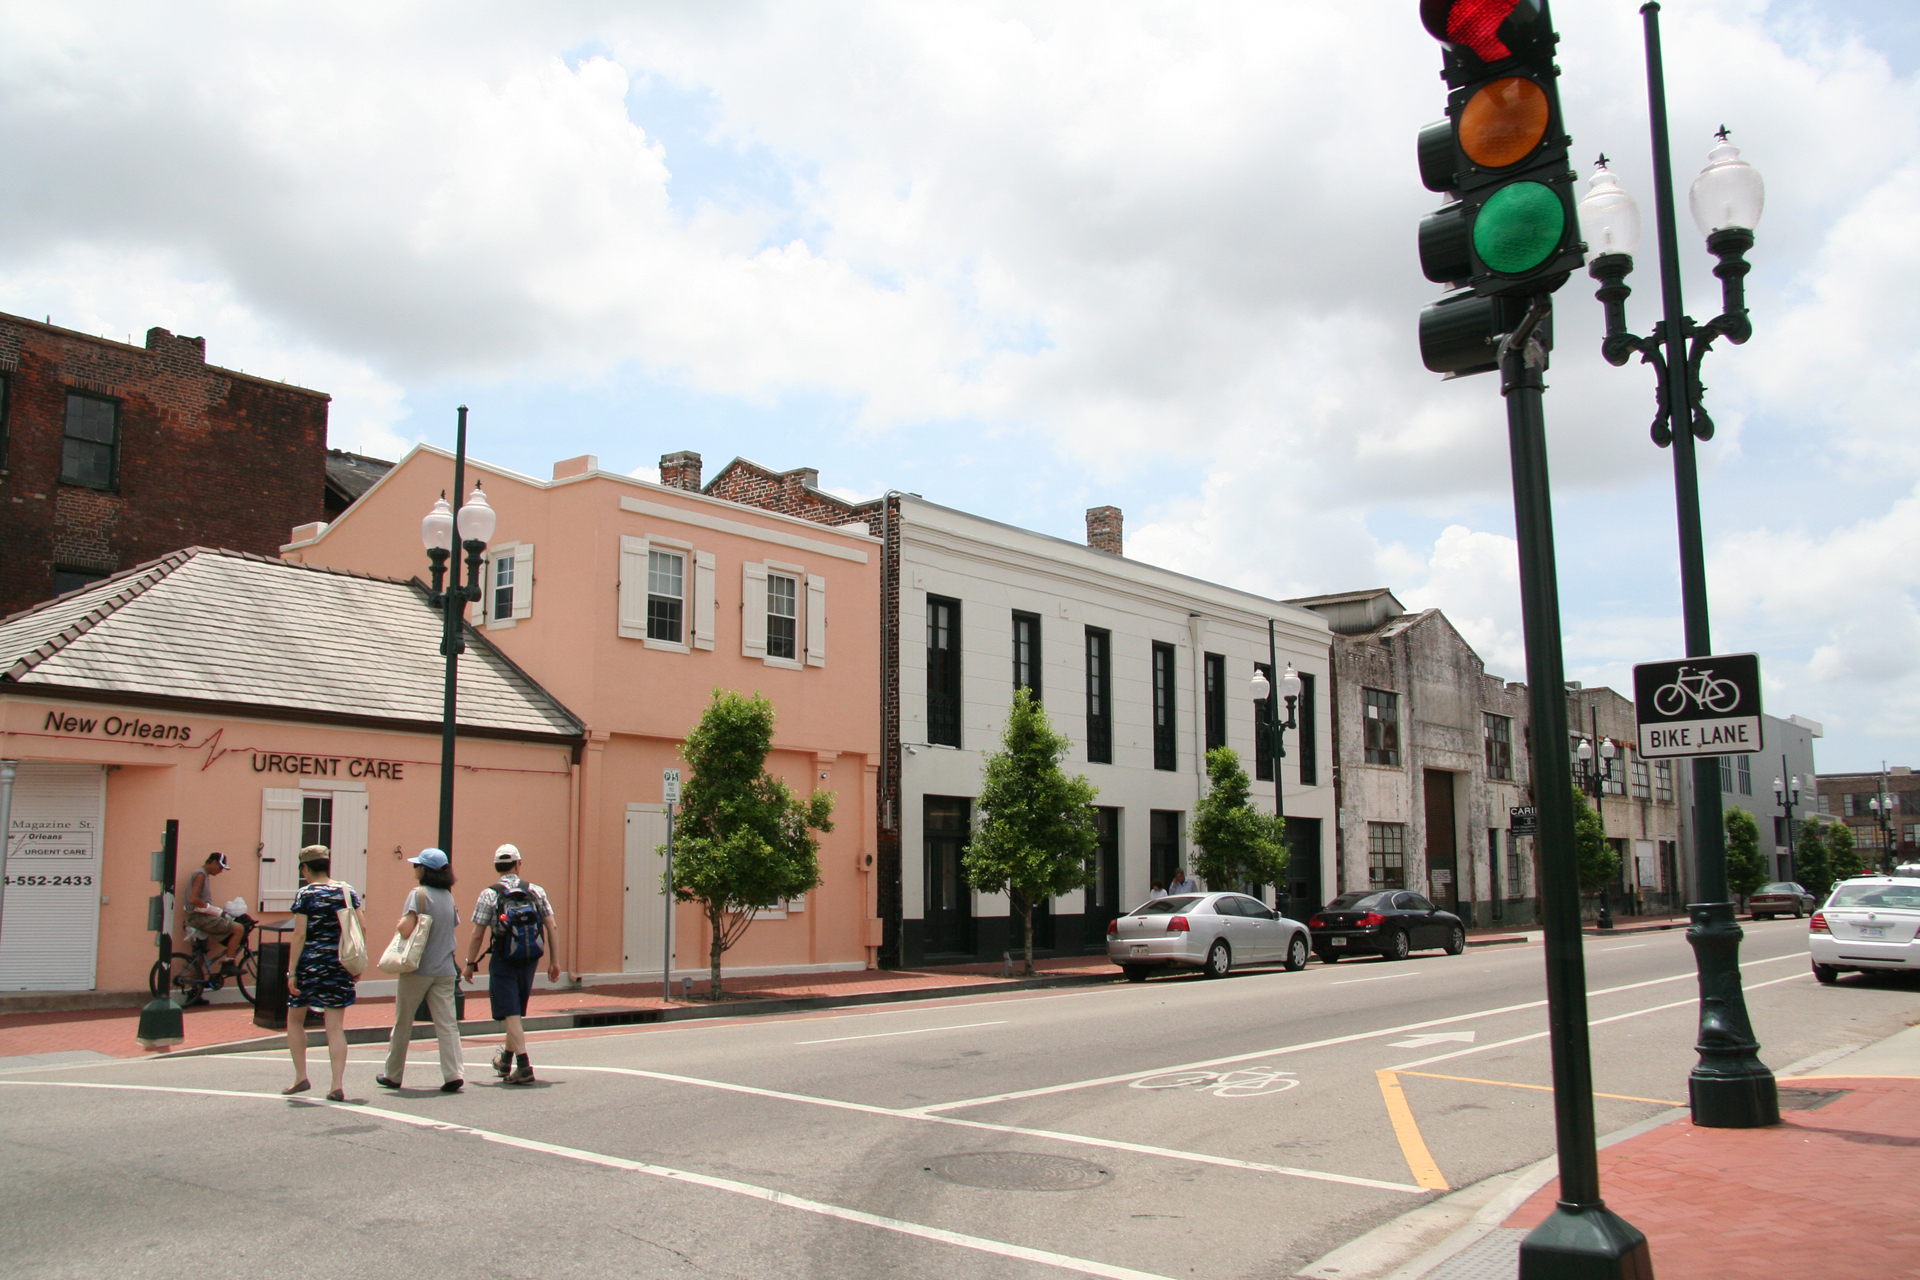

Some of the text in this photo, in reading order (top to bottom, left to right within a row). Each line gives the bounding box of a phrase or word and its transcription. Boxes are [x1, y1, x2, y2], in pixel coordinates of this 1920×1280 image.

[44, 710, 192, 741] New Orleans
[1650, 724, 1749, 748] BIKE LANE
[252, 753, 404, 780] URGENT CARE
[1510, 806, 1538, 816] CARI
[11, 820, 95, 830] Magazine St.
